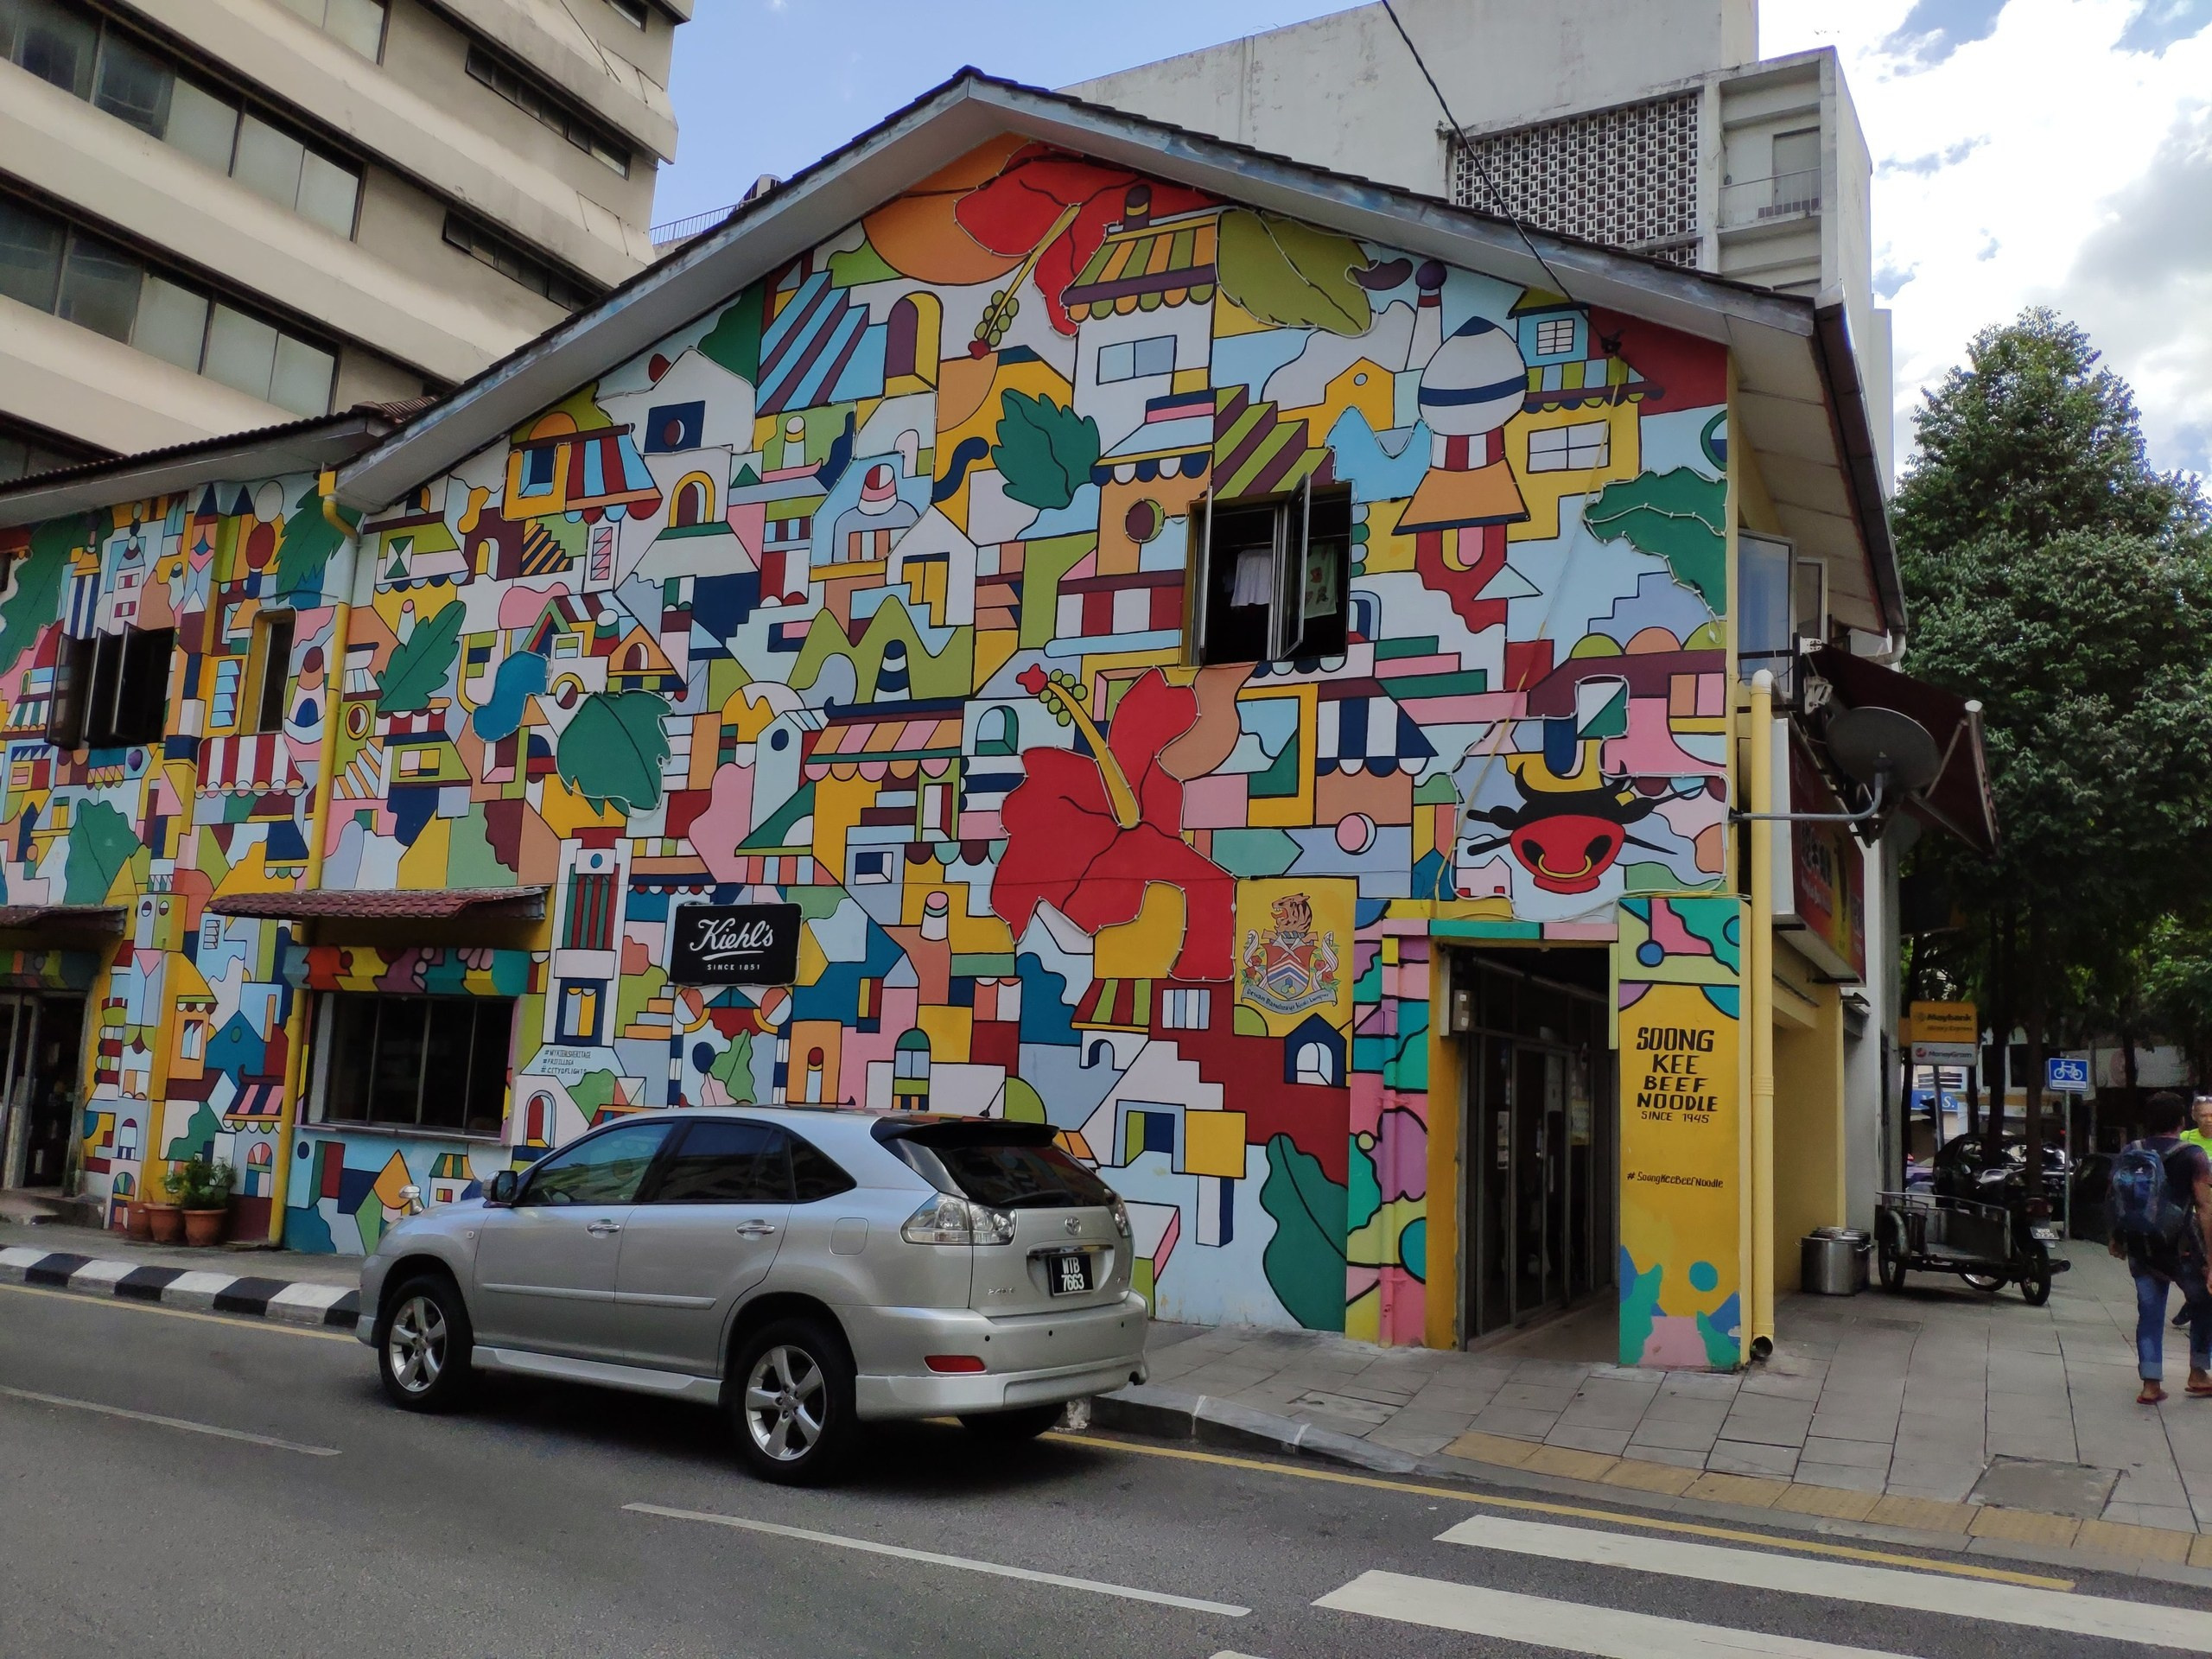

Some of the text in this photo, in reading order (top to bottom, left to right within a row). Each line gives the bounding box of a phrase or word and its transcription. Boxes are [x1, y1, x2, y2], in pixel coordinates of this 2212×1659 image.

[690, 918, 773, 950] Kiehl's
[1927, 1014, 1972, 1022] Maybank
[1637, 1027, 1715, 1052] SOONG
[1652, 1054, 1700, 1074] KEE
[1643, 1075, 1709, 1093] BEEF
[1637, 1092, 1719, 1112] NOODLE
[1641, 1111, 1710, 1123] SINCE 1945
[1062, 1256, 1080, 1274] WTB
[1061, 1274, 1084, 1292] 7663
